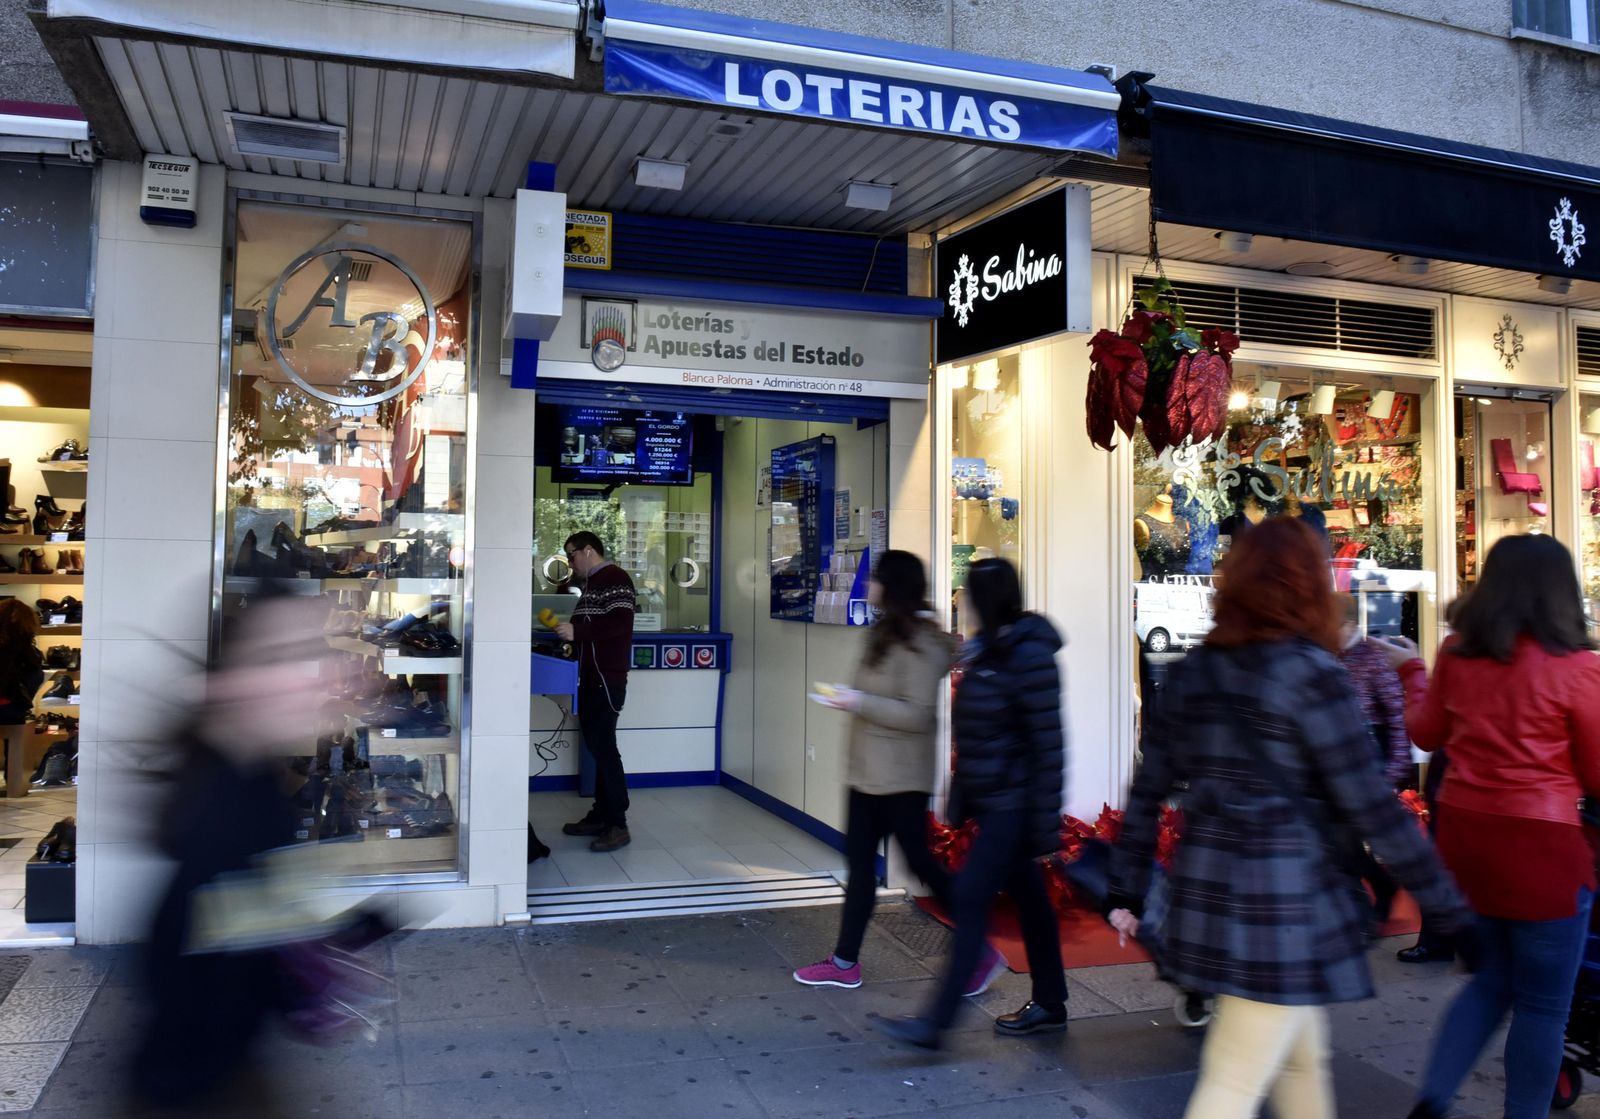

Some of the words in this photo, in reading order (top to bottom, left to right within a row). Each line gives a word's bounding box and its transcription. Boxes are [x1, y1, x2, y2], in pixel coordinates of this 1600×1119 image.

[725, 62, 1021, 141] LOTERIAS
[148, 160, 191, 173] TECSEGUR
[565, 212, 607, 224] NECTADA
[564, 253, 606, 265] OSEGUR
[981, 243, 1062, 301] Sabina
[643, 308, 734, 334] Loterías
[643, 334, 747, 360] Apuestas
[753, 340, 786, 363] del
[791, 344, 865, 369] Estado
[682, 372, 715, 385] Blanca
[717, 374, 753, 386] Paloma
[763, 377, 836, 391] Administración
[849, 382, 863, 392] 48
[1249, 437, 1401, 502] Sabina
